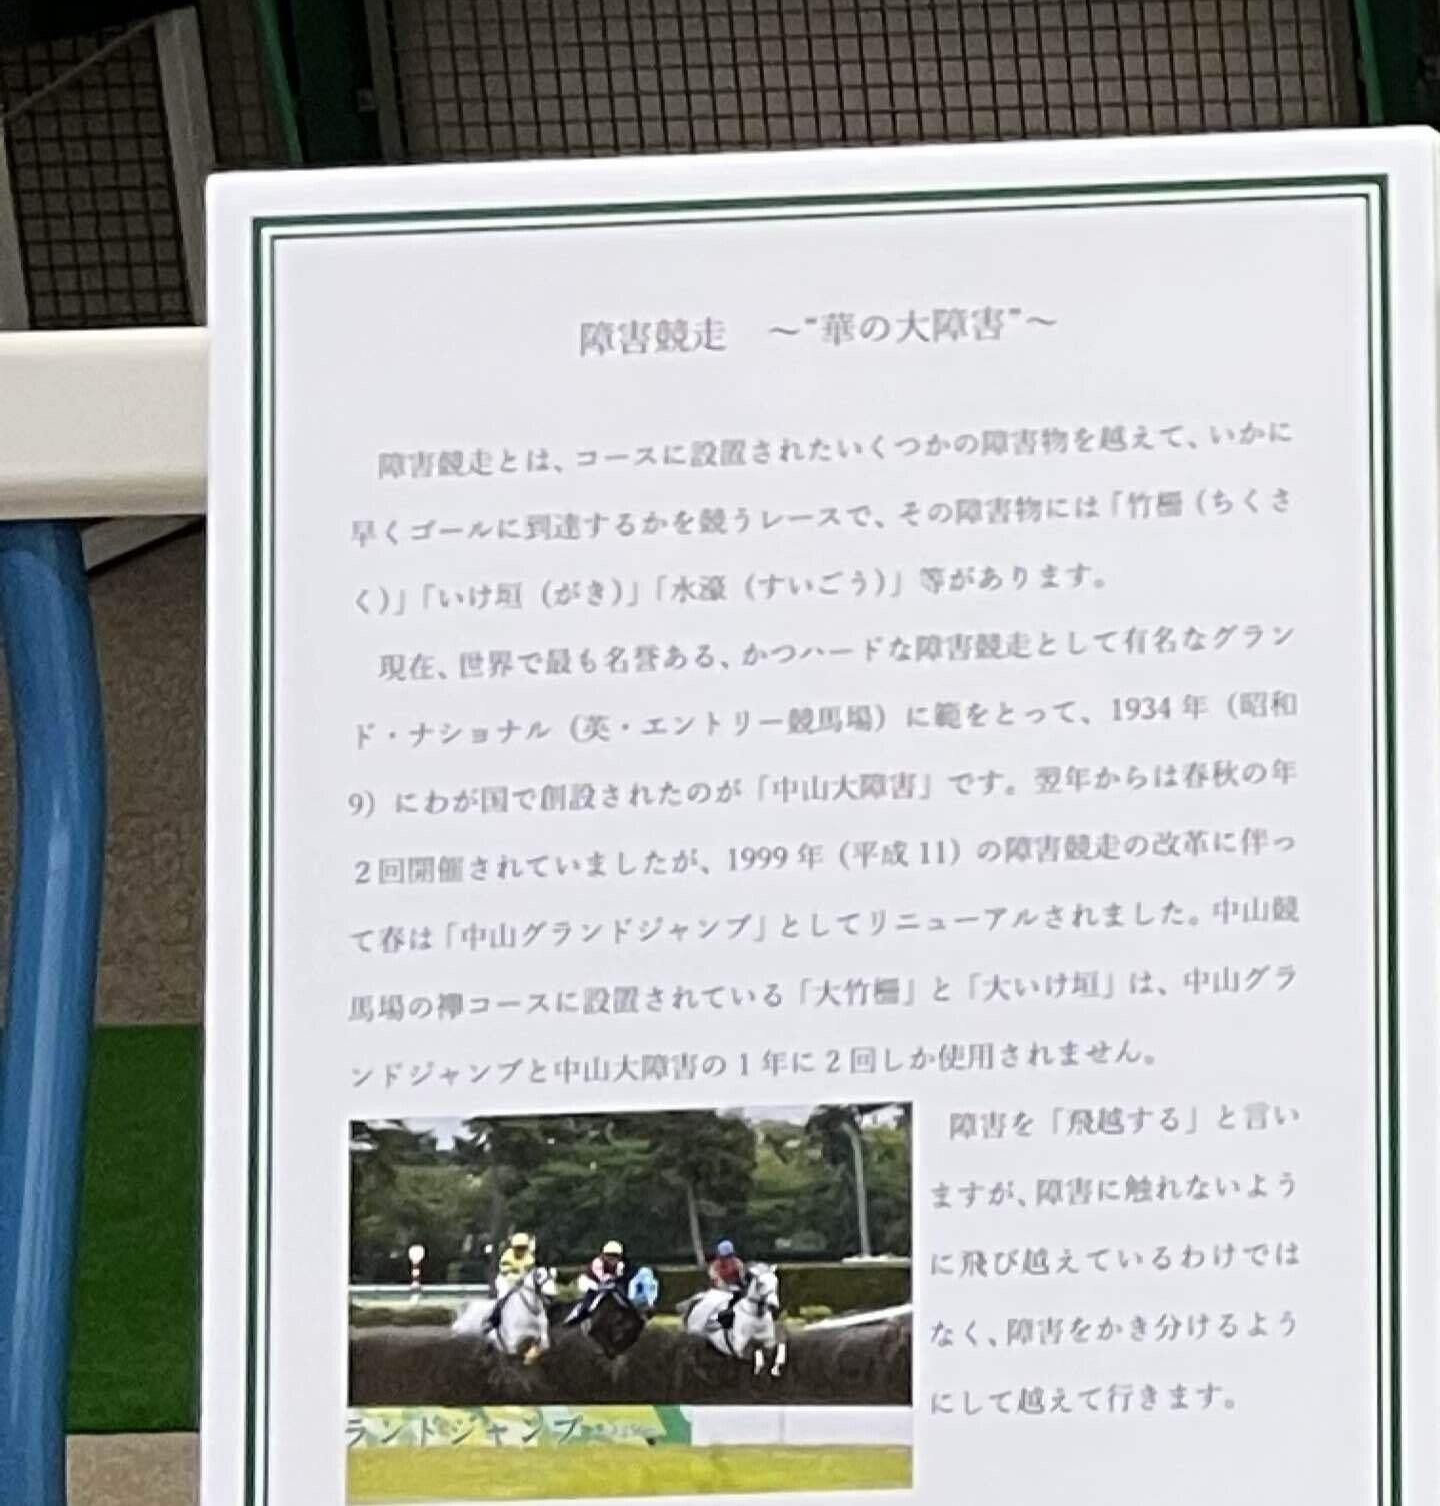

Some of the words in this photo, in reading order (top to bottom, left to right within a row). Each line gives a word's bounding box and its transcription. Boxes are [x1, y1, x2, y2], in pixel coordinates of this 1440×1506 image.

[580, 316, 726, 357] 障害競走
[379, 422, 1292, 479] 障害競走とは、コースに設置されたいくつかの障害物を越えて、いかに
[379, 625, 1294, 681] 現在、世界で最も名誉ある、かつハードな障害競走として有名なグラン
[950, 1102, 1299, 1140] 障害を「飛越する」と言い
[932, 1172, 1295, 1208] ますが、障害に触れないよう
[931, 1242, 1299, 1278] に飛び越えているわけでは
[931, 1311, 1295, 1348] なく、障害をかき分けるよう
[931, 1382, 1234, 1416] にして越えて行きます。
